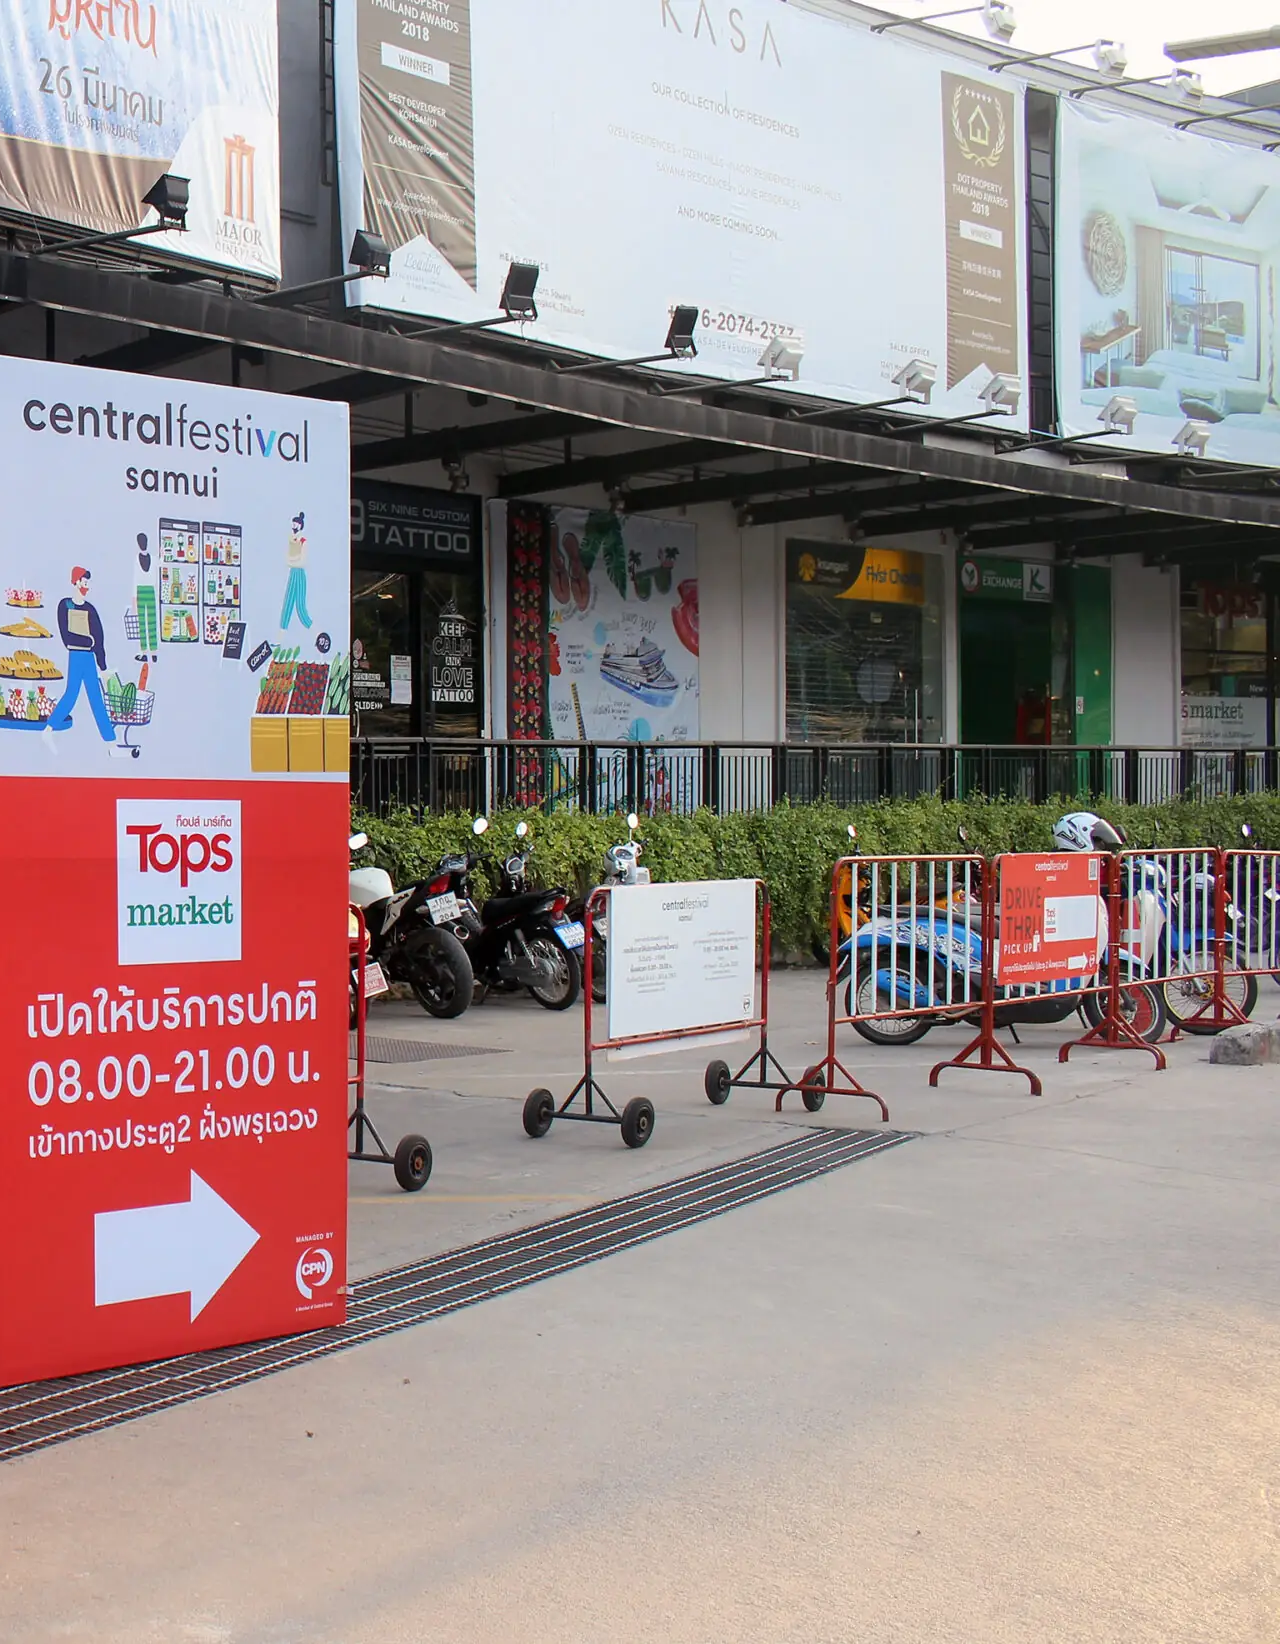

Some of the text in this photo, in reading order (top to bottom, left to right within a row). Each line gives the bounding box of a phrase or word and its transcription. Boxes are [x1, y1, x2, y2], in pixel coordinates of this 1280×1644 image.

[401, 20, 430, 42] 2018
[420, 11, 459, 34] AWARDS
[398, 53, 434, 75] WINNER
[38, 57, 163, 127] 26 มีนาคม
[388, 92, 447, 118] BEST DEVELOPER
[651, 81, 800, 139] OUR COLLECTION OF RESIDENCES
[388, 134, 449, 161] KASA Development
[630, 130, 677, 154] RESIDENCES
[957, 172, 1003, 194] DOT PROPERTY
[952, 183, 1009, 209] THAILAND AWARDS
[677, 205, 753, 234] AND MORE COMING
[971, 201, 990, 217] 2018
[215, 218, 262, 247] MAJOR
[23, 399, 309, 463] centralfestival
[125, 466, 218, 499] samui
[368, 500, 471, 524] SIX NINE CUSTOM
[368, 523, 471, 554] TATTOO
[982, 575, 1023, 589] EXCHANGE
[439, 622, 466, 637] KEEP
[432, 636, 472, 657] CALM
[445, 656, 462, 666] AND
[432, 666, 474, 688] LOVE
[432, 690, 474, 702] TATTOO
[1190, 700, 1244, 719] market
[126, 823, 233, 888] Tops
[127, 893, 234, 928] market
[662, 897, 709, 911] centralfestival
[1006, 886, 1041, 911] DRIVE
[1003, 943, 1033, 955] PICK UP
[27, 980, 318, 1039] เปิดให้บริการปกติ
[28, 1045, 321, 1107] 08.00-21.00 น.
[199, 1101, 319, 1145] ฝั่งพรุเฉวง
[295, 1233, 324, 1243] MANAGED
[301, 1261, 326, 1276] CPN
